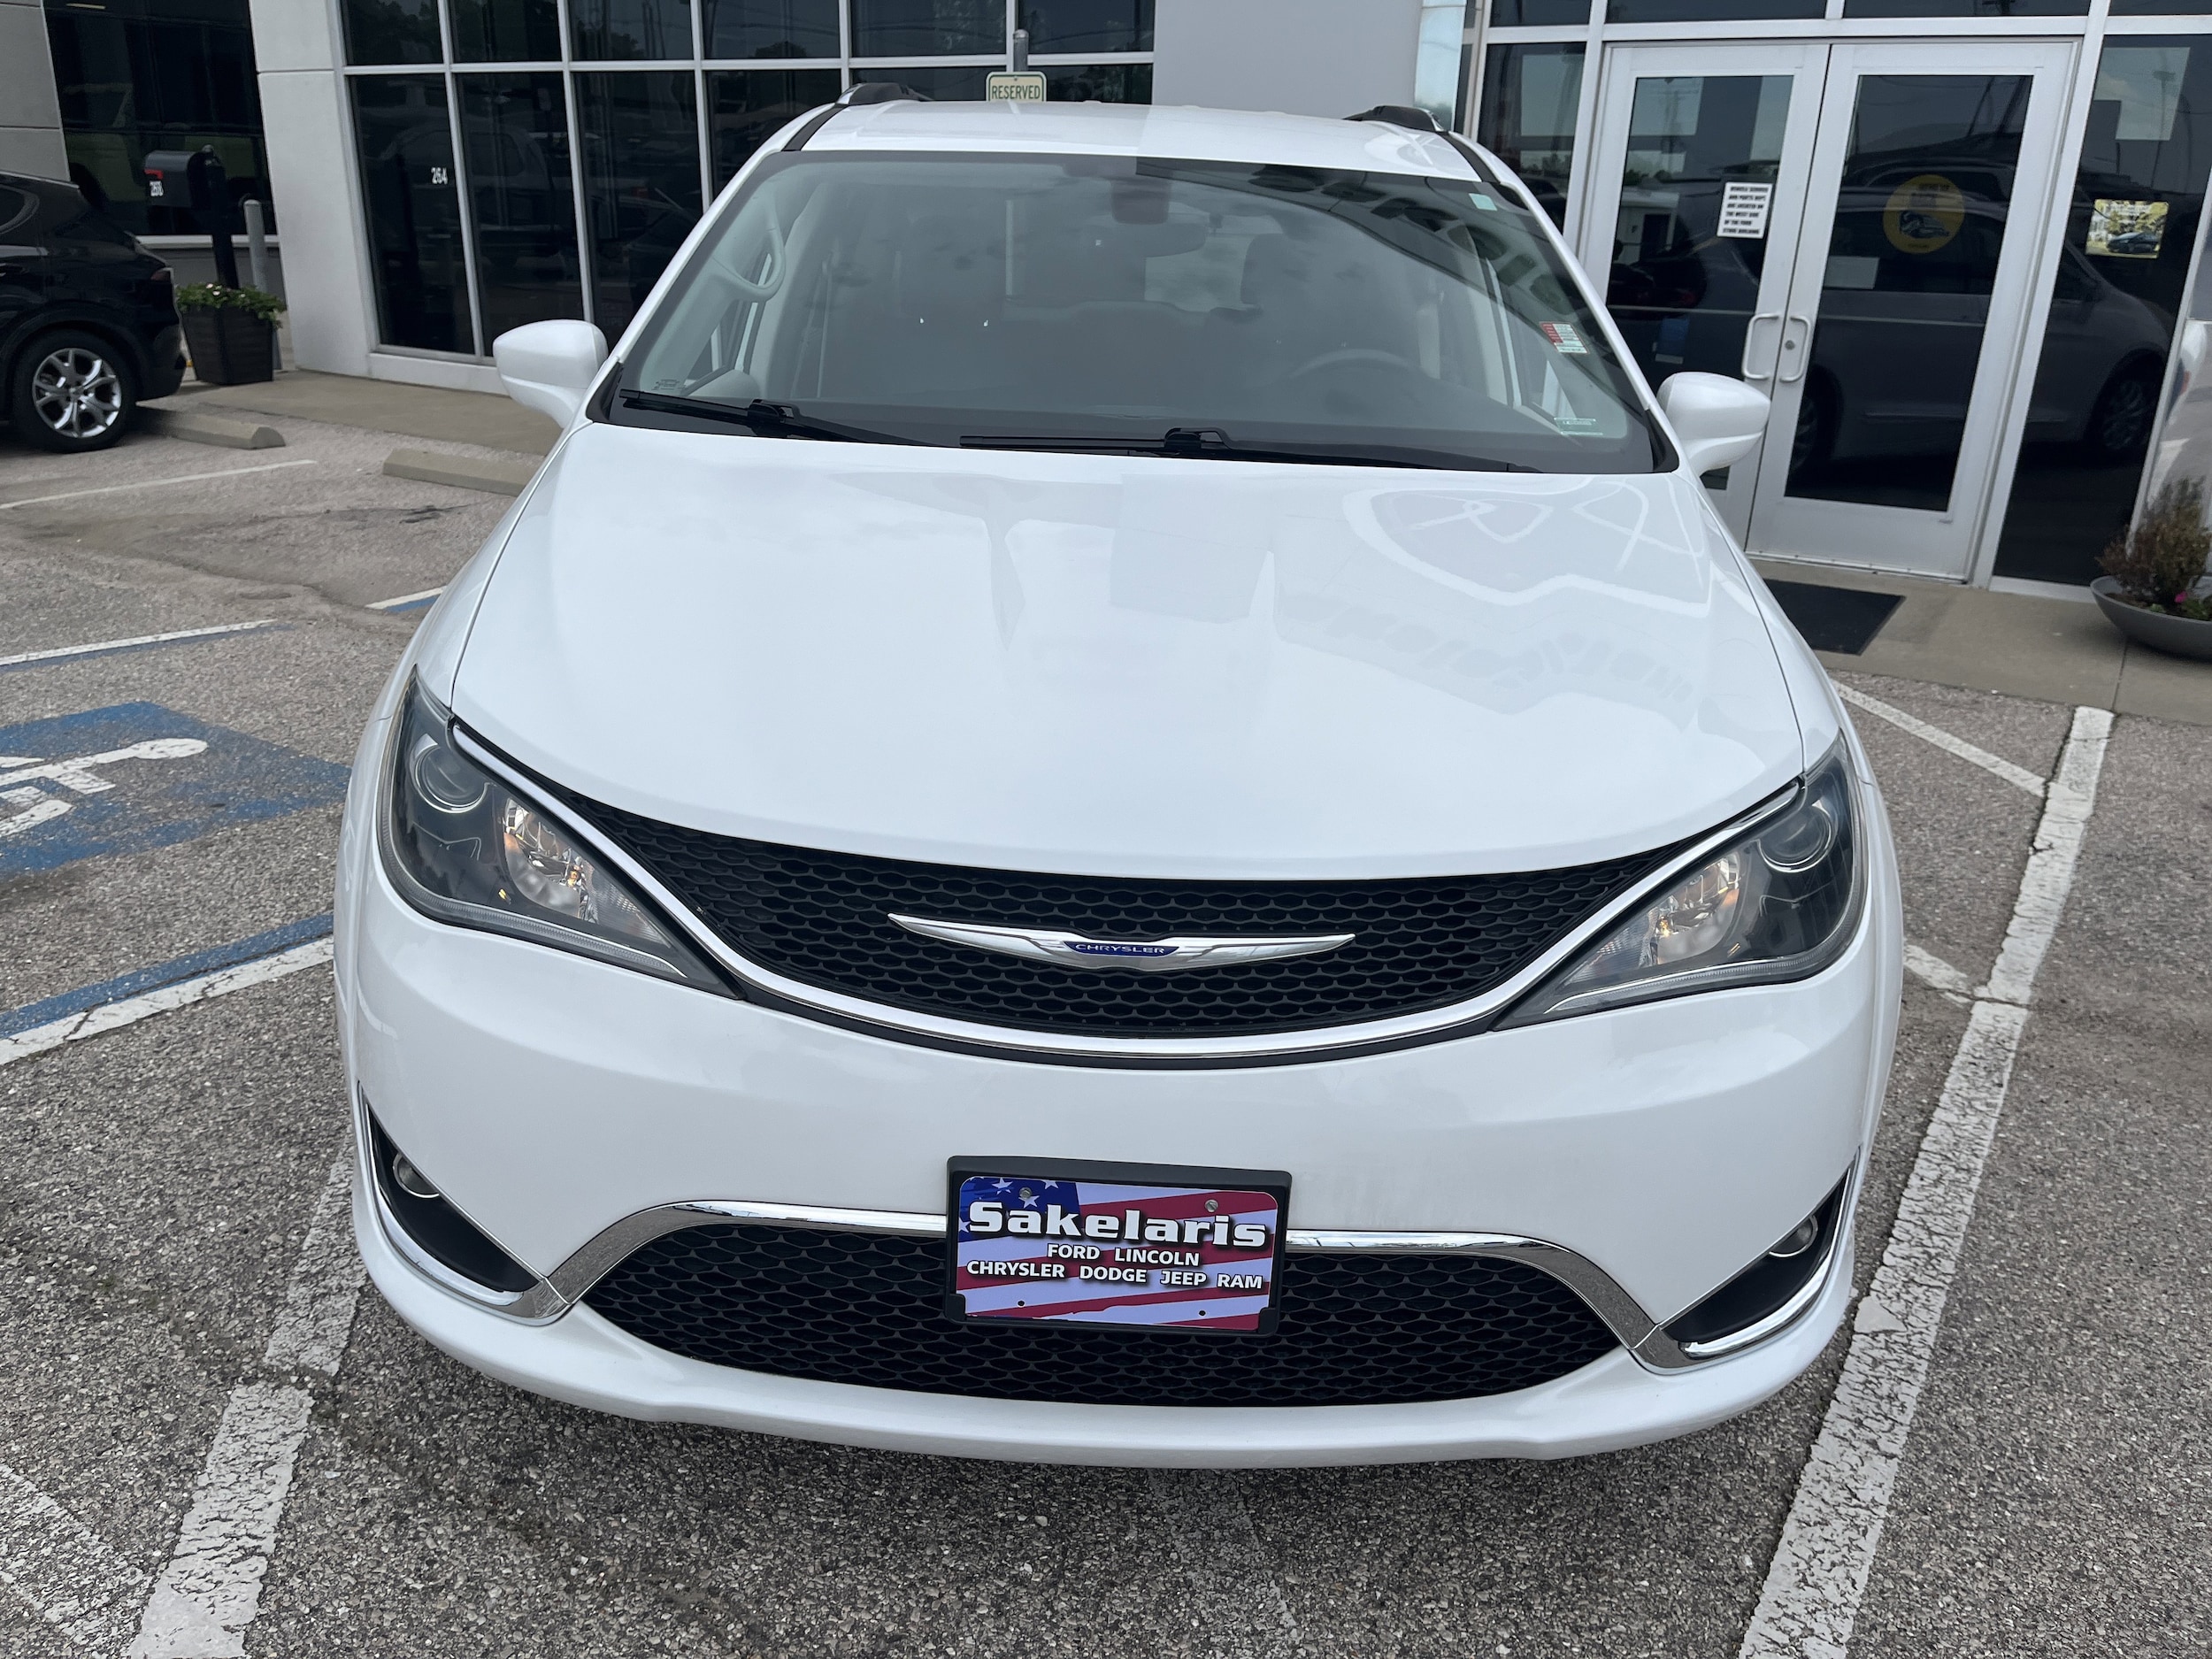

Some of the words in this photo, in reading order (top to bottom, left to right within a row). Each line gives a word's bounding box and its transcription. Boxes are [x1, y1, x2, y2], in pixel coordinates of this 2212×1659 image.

[991, 85, 1041, 100] RESERVED
[1075, 943, 1165, 954] CHRYSLER
[968, 1200, 1268, 1248] Sakelaris
[1047, 1243, 1101, 1261] FORD
[1114, 1248, 1200, 1267] LINCOLN
[966, 1260, 1066, 1279] CHRYSLER
[1079, 1264, 1148, 1283] DODGE
[1159, 1270, 1208, 1287] JEEP
[1217, 1273, 1263, 1289] RAM
